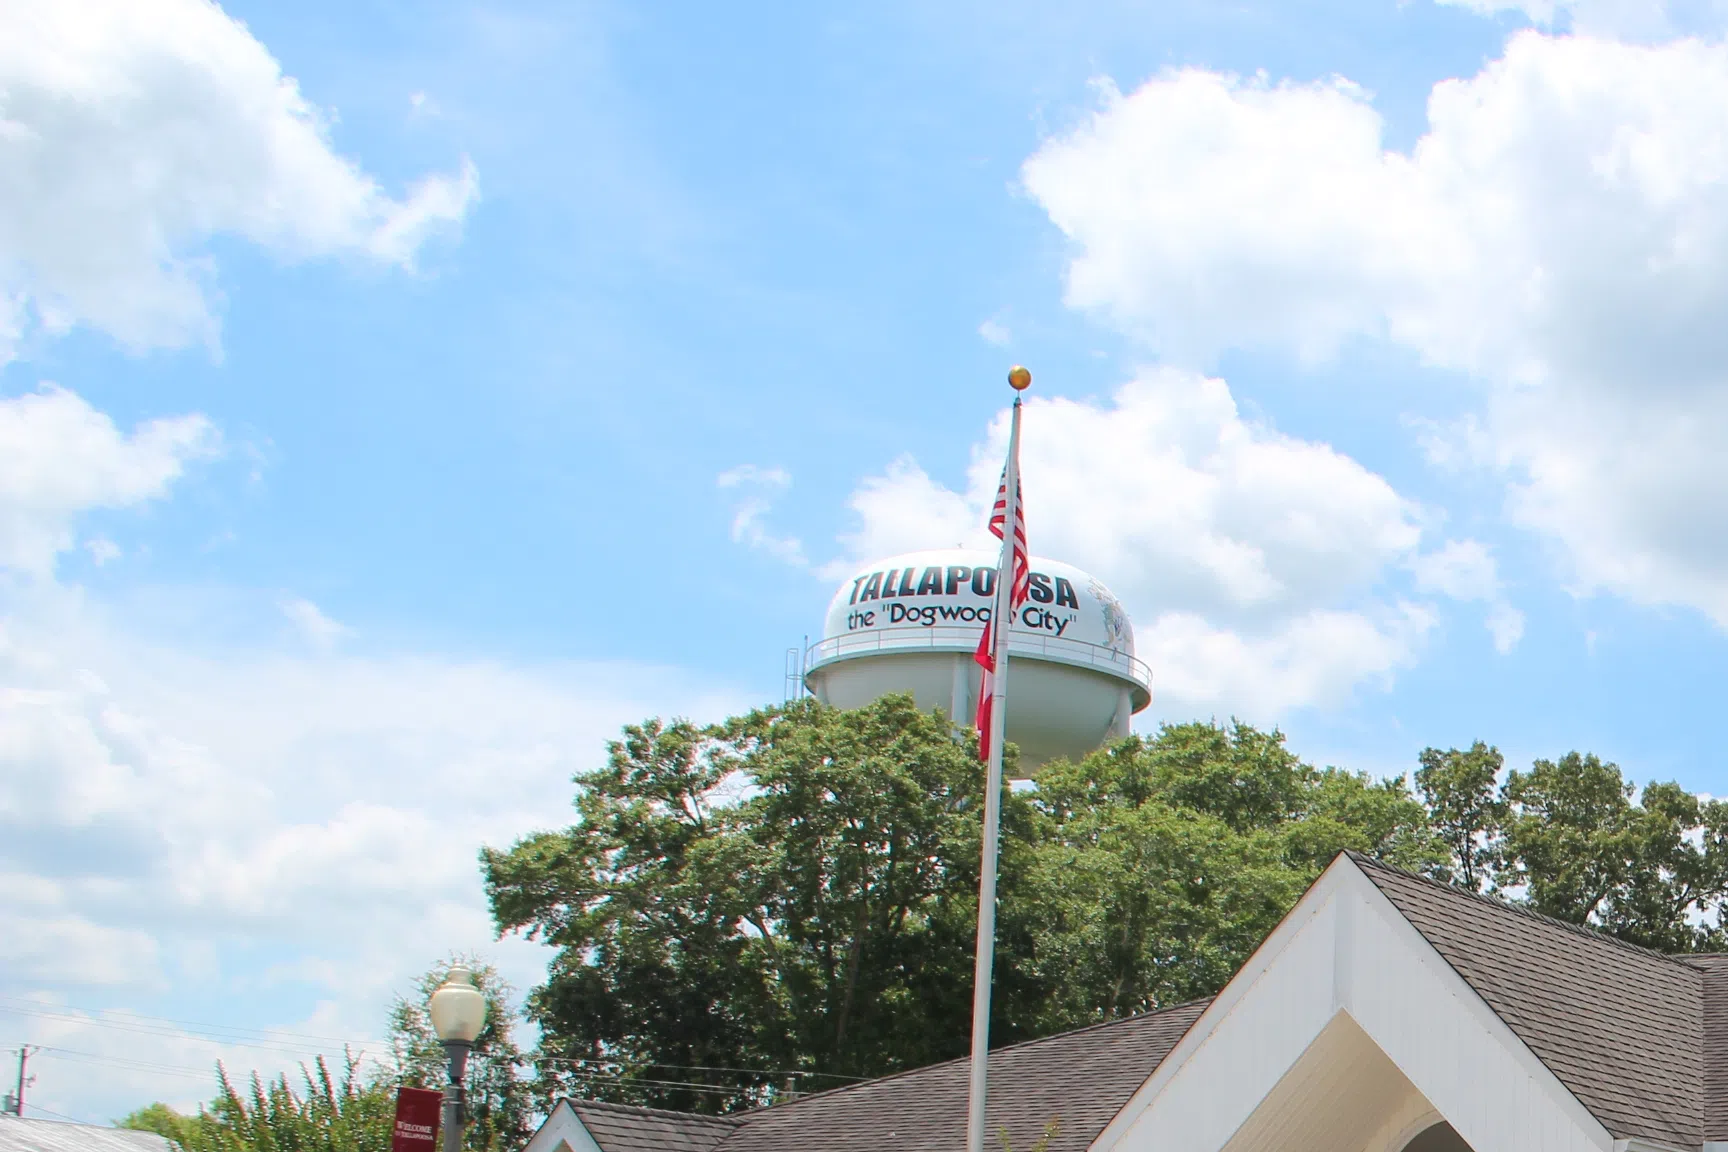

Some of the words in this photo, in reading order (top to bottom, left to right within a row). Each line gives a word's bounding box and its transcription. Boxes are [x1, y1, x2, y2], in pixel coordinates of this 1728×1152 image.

[849, 566, 1079, 610] TALLAPOSA
[848, 609, 875, 630] the
[883, 603, 1016, 626] "Dogwoo
[1022, 606, 1077, 636] City"
